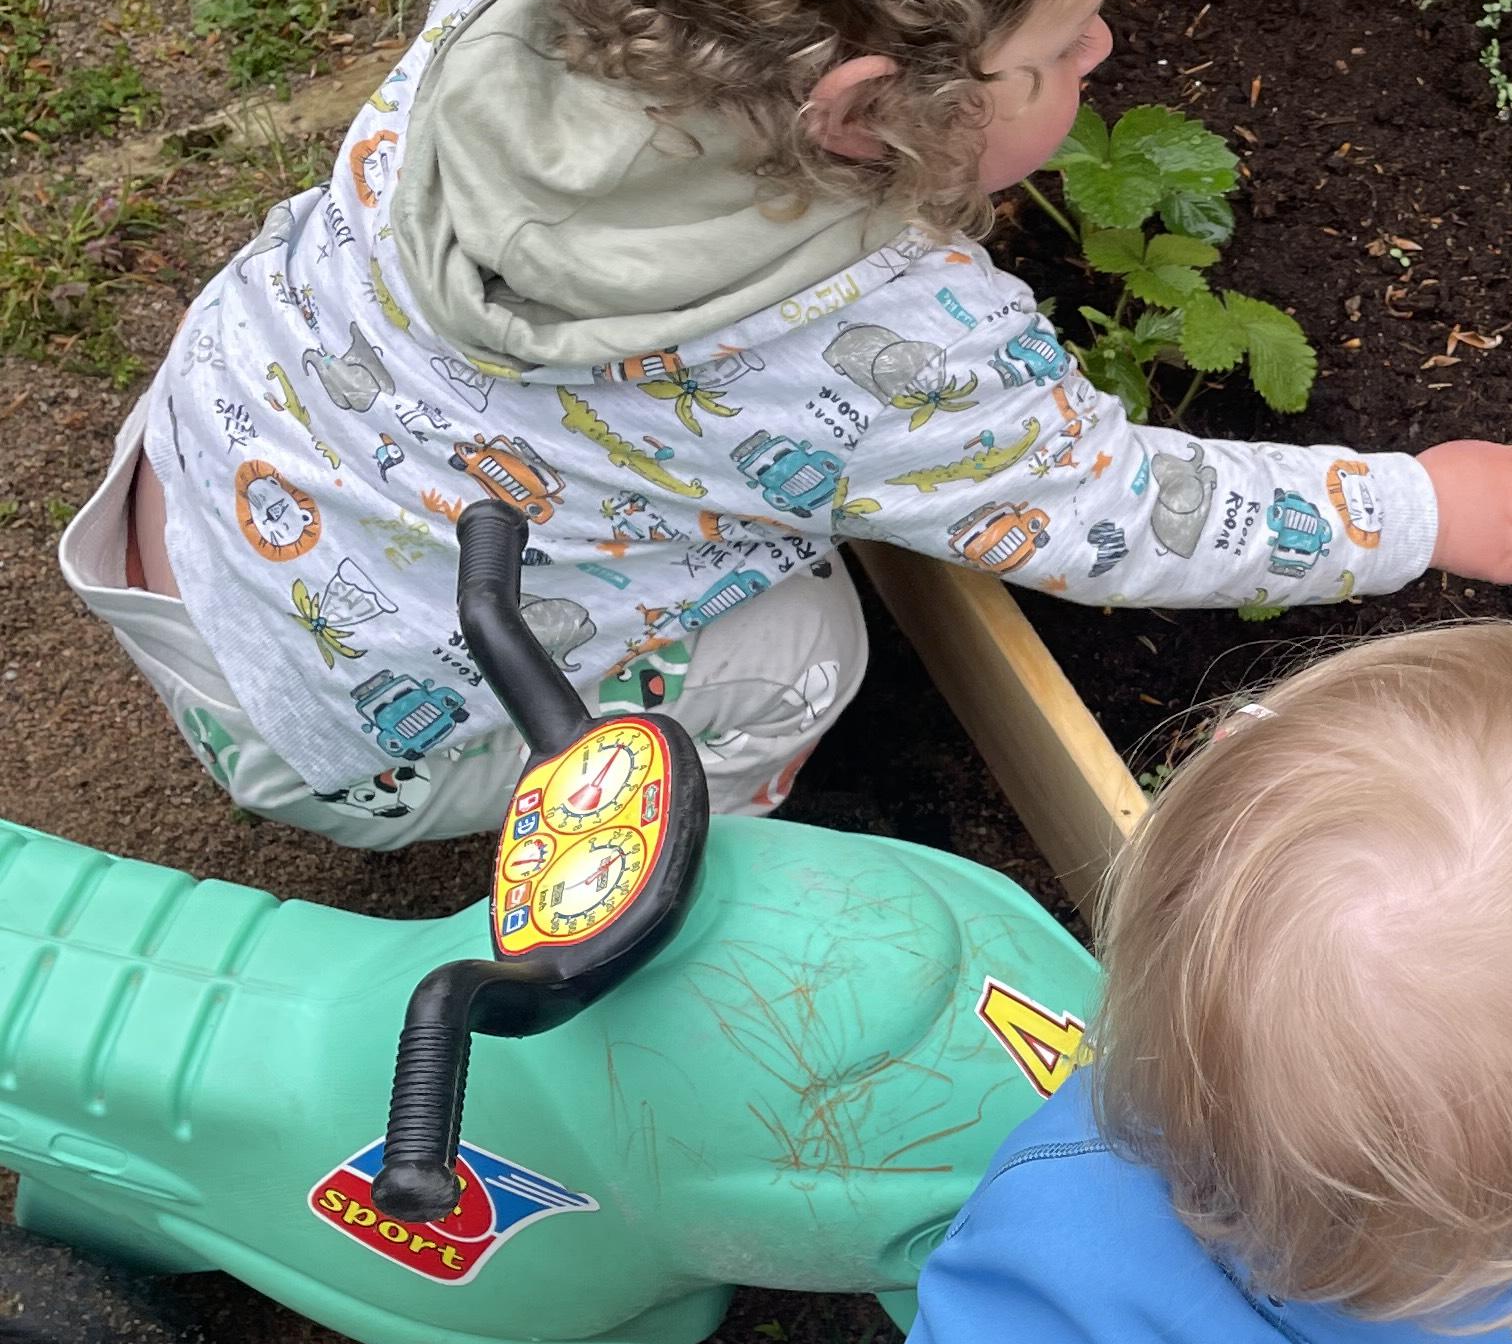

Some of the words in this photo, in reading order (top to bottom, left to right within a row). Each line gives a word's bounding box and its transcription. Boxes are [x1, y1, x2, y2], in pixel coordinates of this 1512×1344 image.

[1213, 490, 1244, 550] ROOAR
[978, 981, 1090, 1096] 4
[318, 1188, 466, 1272] sport
